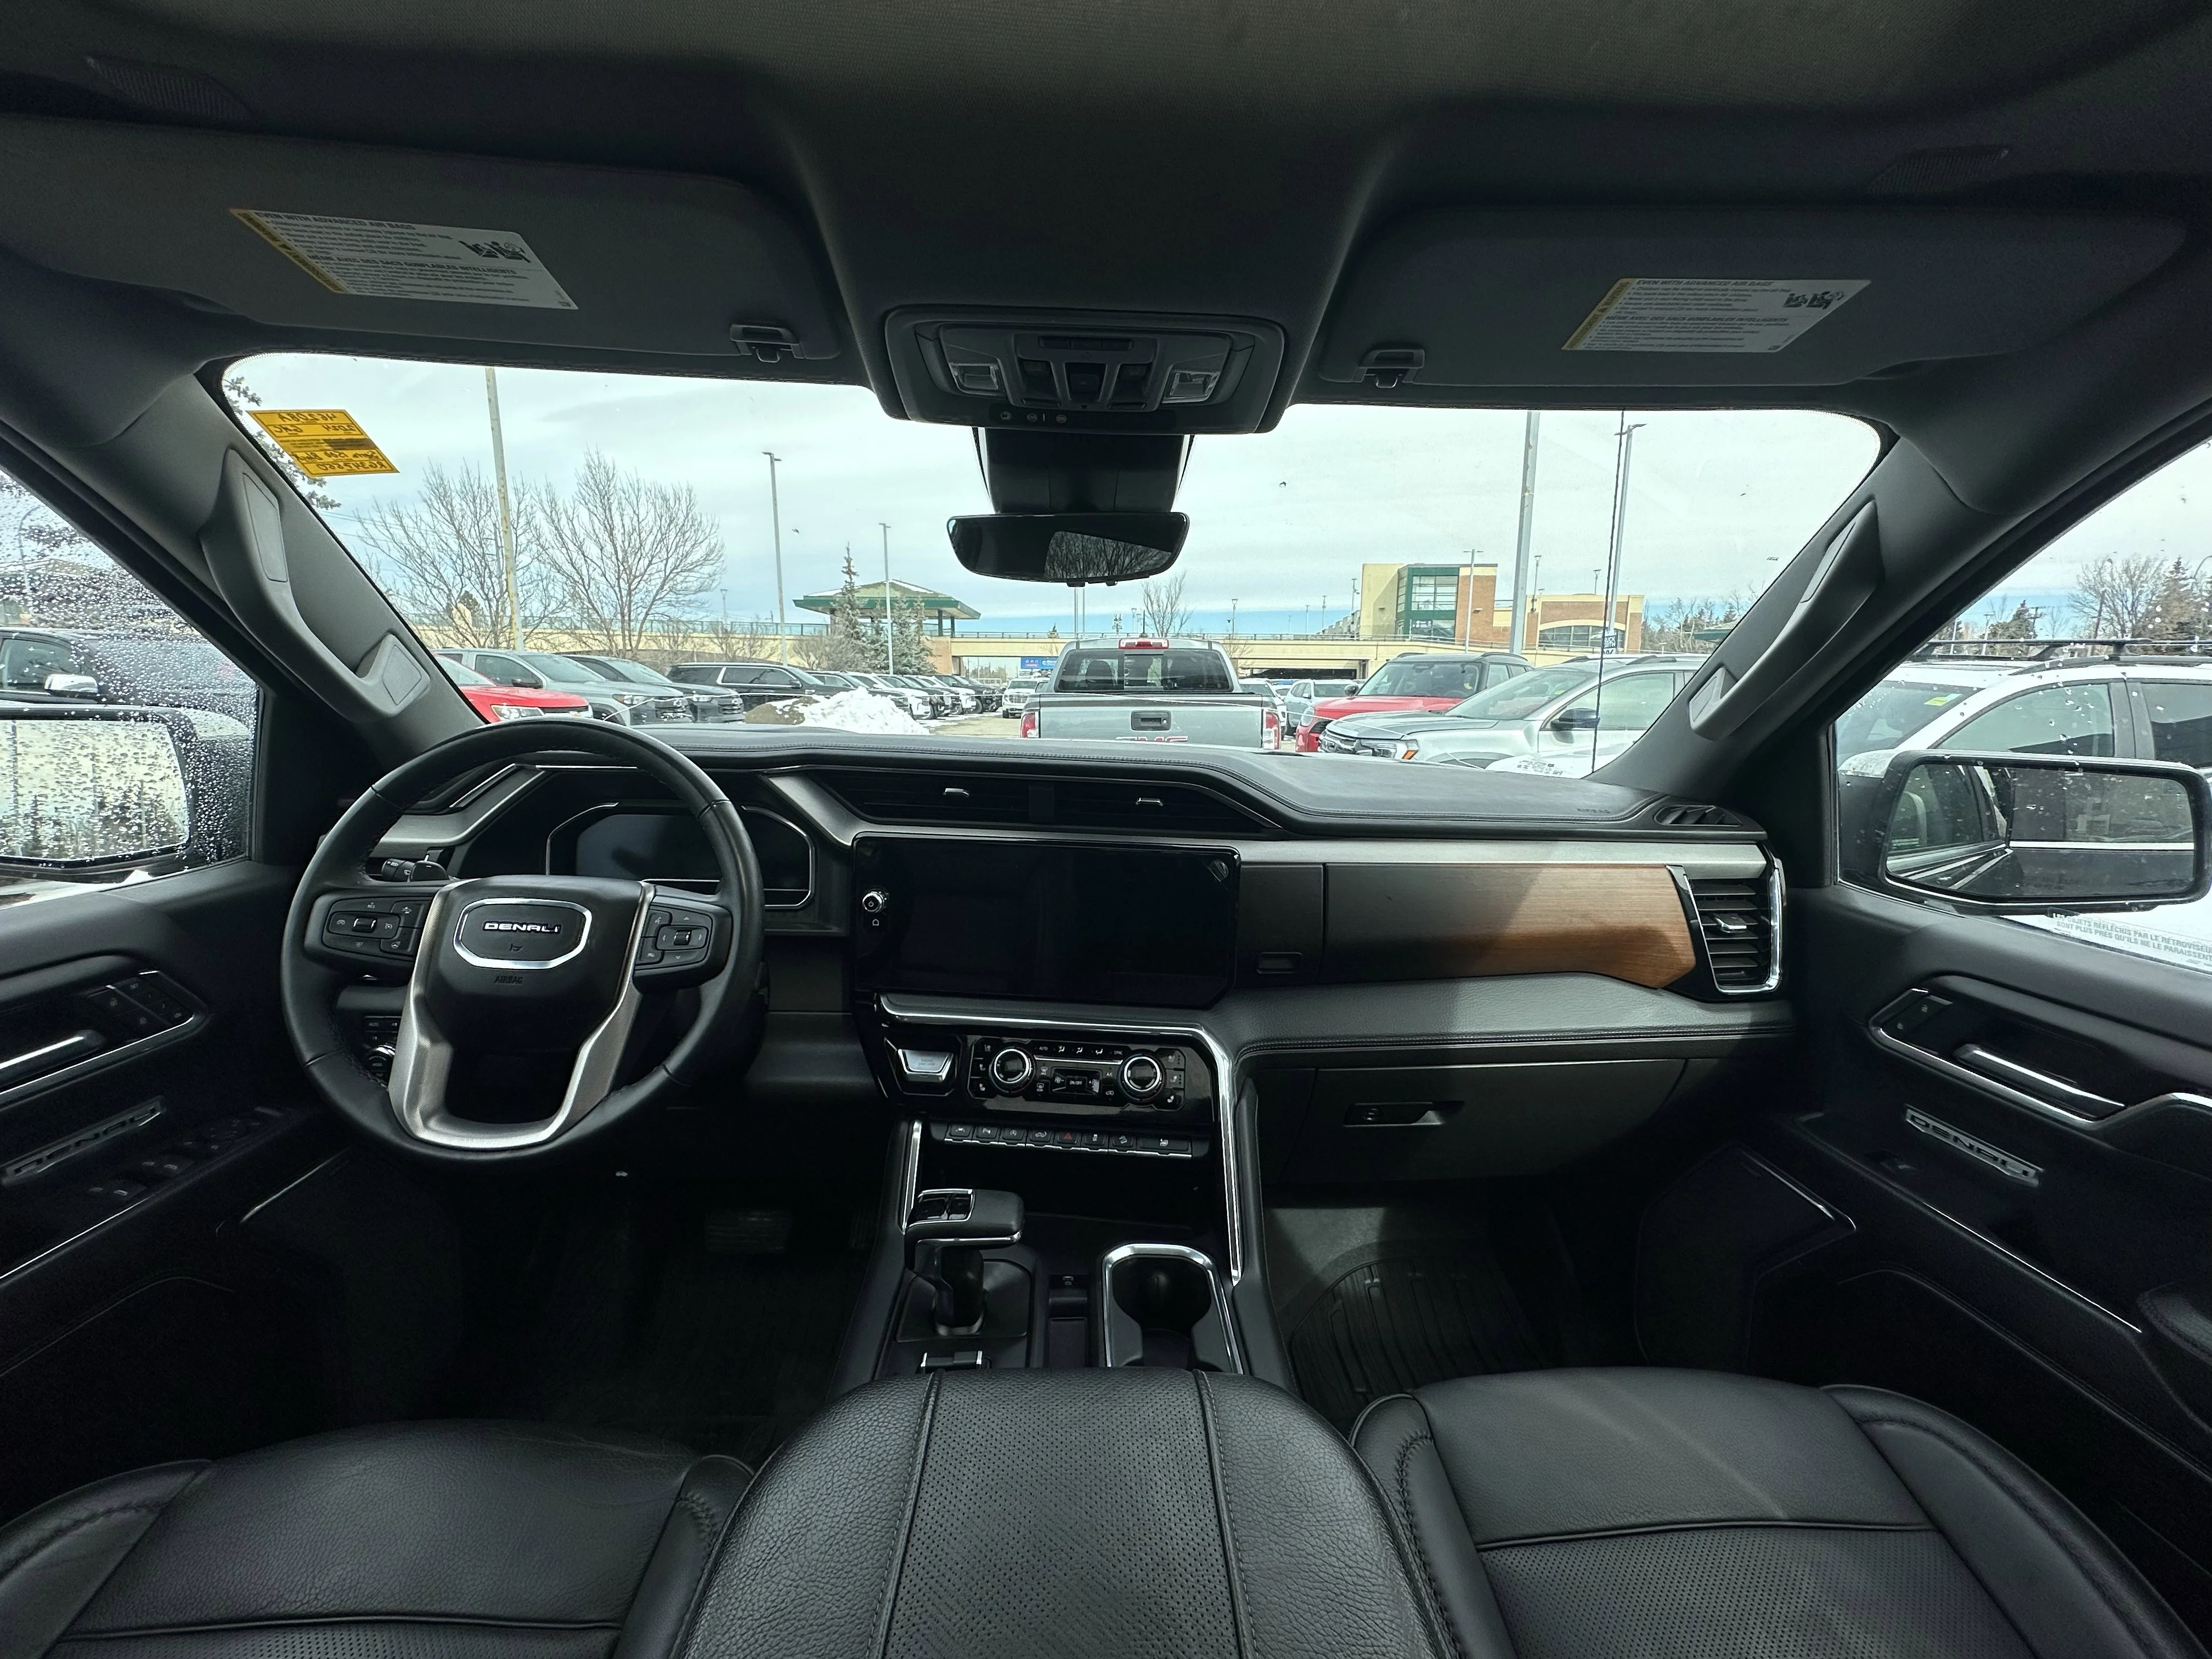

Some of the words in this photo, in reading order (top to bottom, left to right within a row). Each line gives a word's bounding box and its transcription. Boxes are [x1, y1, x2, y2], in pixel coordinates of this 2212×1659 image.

[309, 216, 368, 226] ADVANCED
[483, 921, 562, 934] DENALI
[2056, 921, 2074, 930] SONT
[2075, 925, 2093, 934] PLUS
[2094, 921, 2132, 936] RÉFLÉCHIS
[2162, 936, 2212, 954] RÉTROVISEU
[495, 976, 523, 984] AIRBAG
[1910, 1114, 2029, 1177] DENALI
